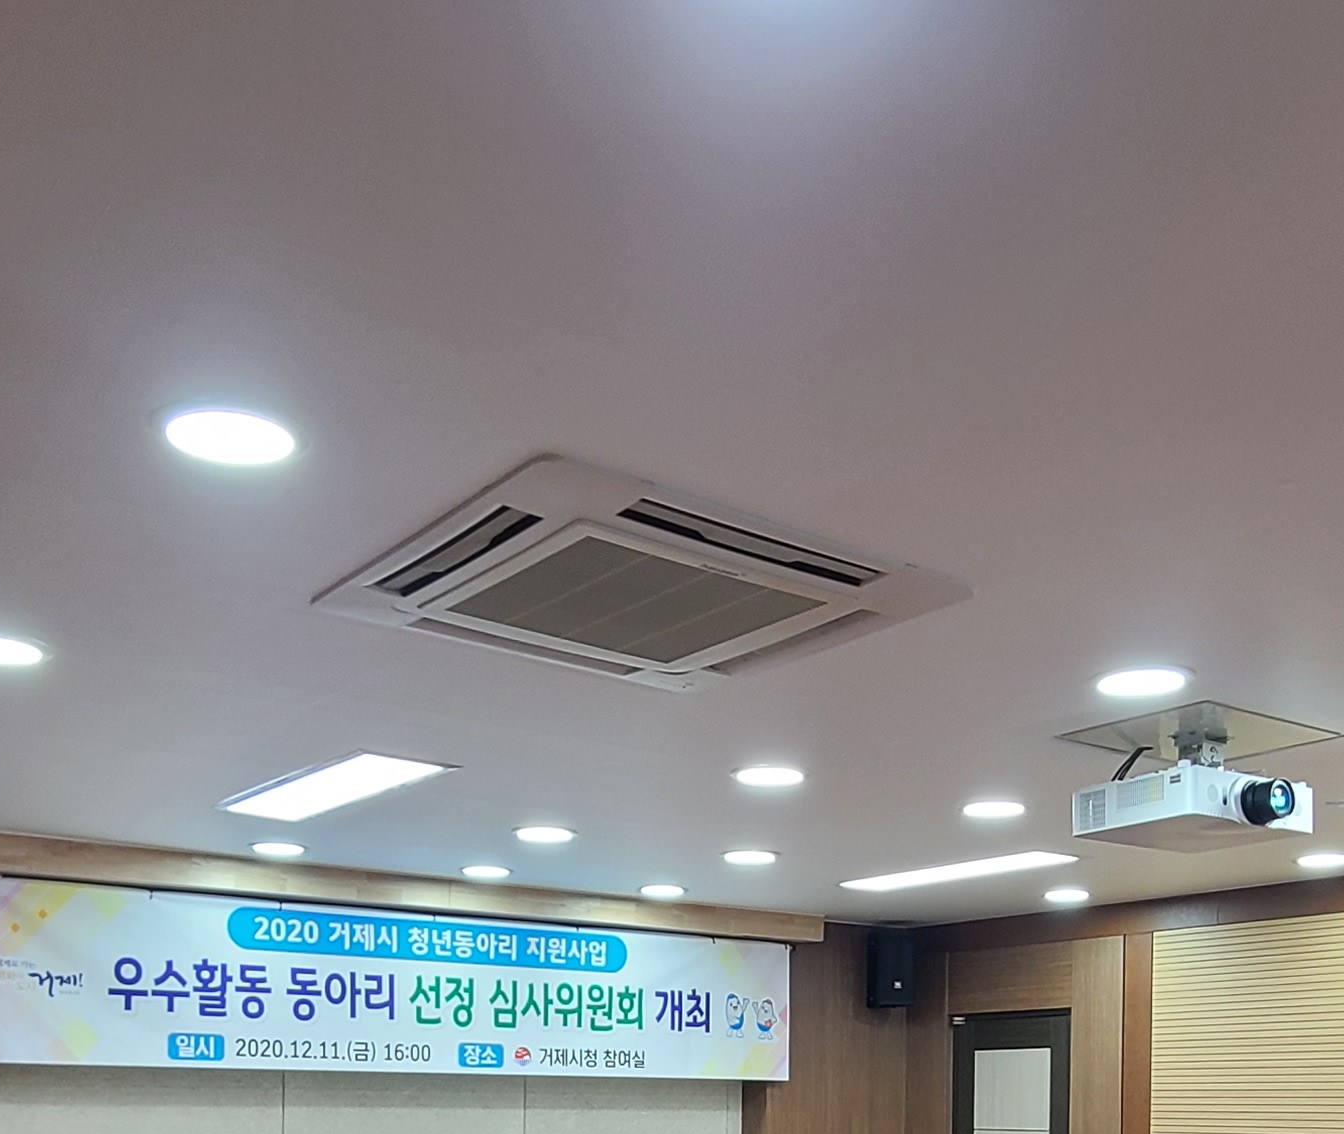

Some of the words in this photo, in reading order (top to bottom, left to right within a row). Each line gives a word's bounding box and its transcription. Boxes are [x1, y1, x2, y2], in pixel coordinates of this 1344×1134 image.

[253, 916, 319, 944] 2020
[328, 921, 398, 953] 거제시
[408, 925, 518, 961] 청년동아리
[526, 936, 607, 967] 지원사업
[108, 957, 272, 1019] 우수활동
[286, 967, 395, 1022] 동아리
[409, 974, 475, 1028] 선정
[489, 978, 644, 1032] 심사위원회
[655, 988, 711, 1033] 개최
[175, 1035, 215, 1058] 일시
[235, 1038, 376, 1062] 2020.12.11.(금)
[384, 1043, 431, 1062] 16:00
[463, 1045, 498, 1066] 장소
[539, 1047, 598, 1068] 거제시청
[603, 1049, 645, 1069] 참여실
